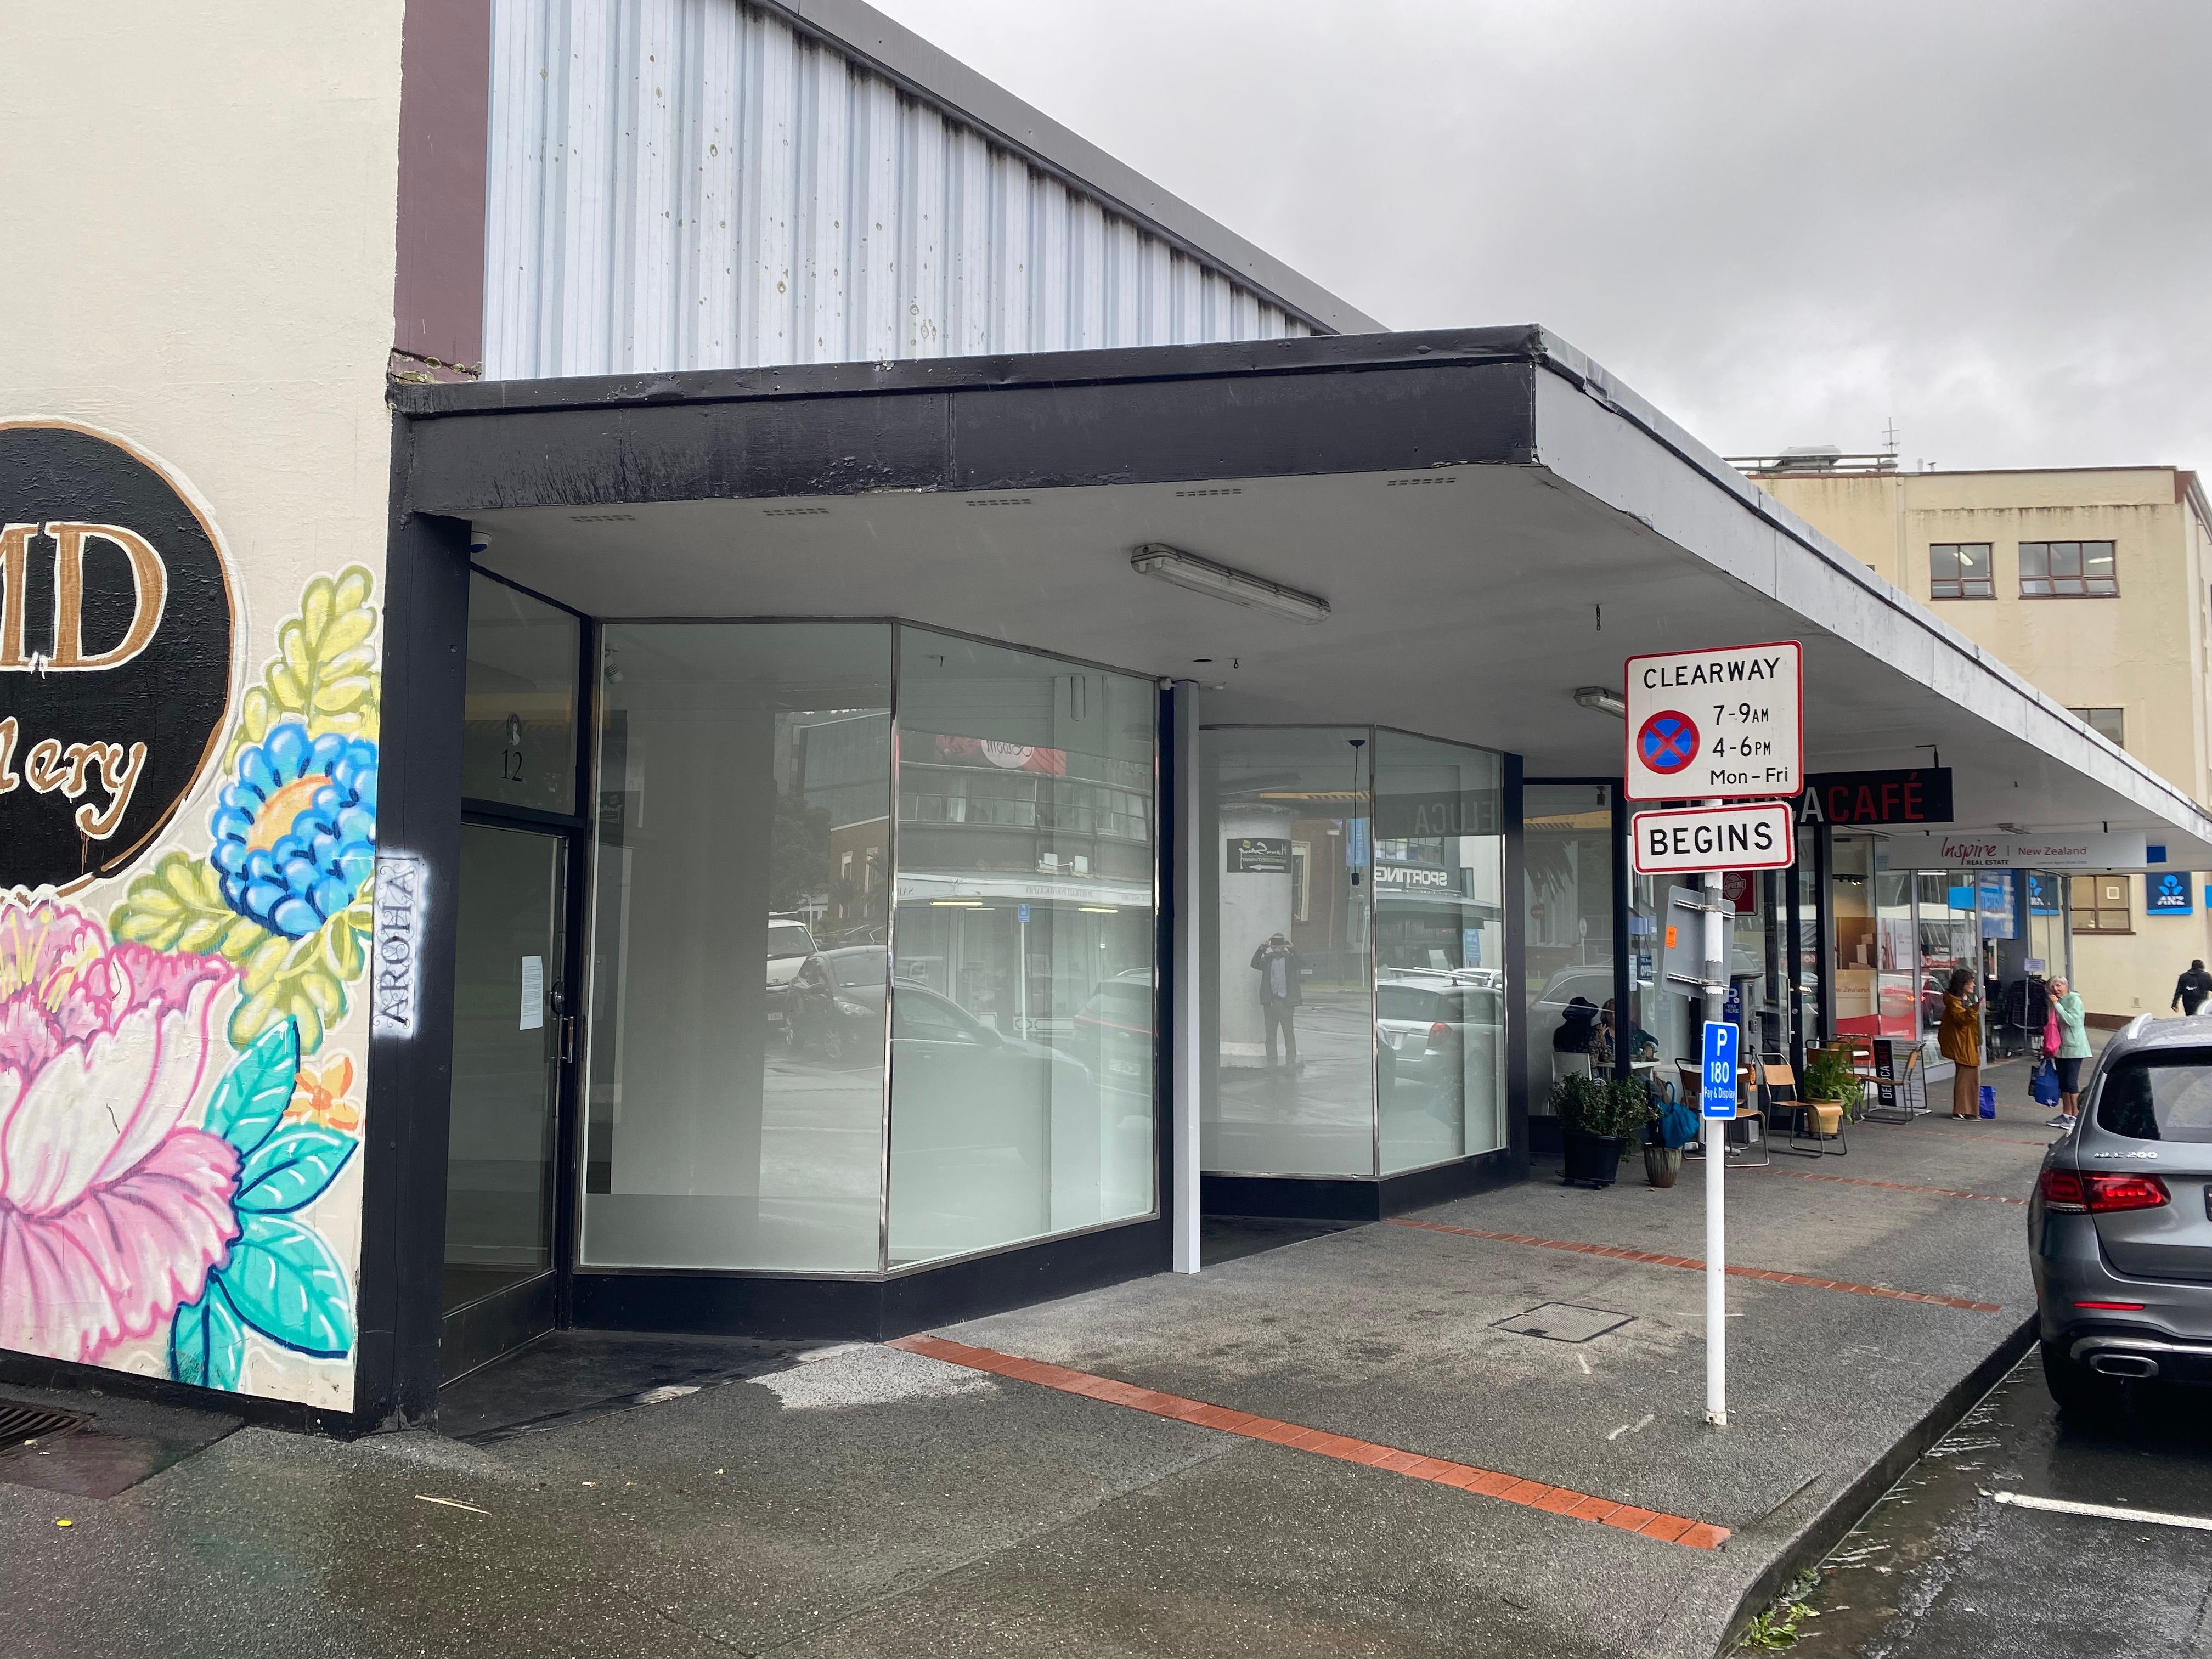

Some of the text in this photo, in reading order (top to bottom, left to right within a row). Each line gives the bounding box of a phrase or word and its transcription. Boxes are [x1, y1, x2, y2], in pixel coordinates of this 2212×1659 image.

[1643, 657, 1781, 689] CLEARWAY
[501, 748, 523, 782] 12
[1828, 772, 1925, 821] CAFÉ
[1650, 822, 1773, 856] BEGINS
[1941, 837, 2087, 865] Inspire New Zealand
[2157, 895, 2185, 905] ANZ
[379, 868, 413, 1025] AROHA
[1717, 1028, 1728, 1057] P
[1711, 1061, 1730, 1084] 180
[1704, 1086, 1736, 1102] Pay & Display
